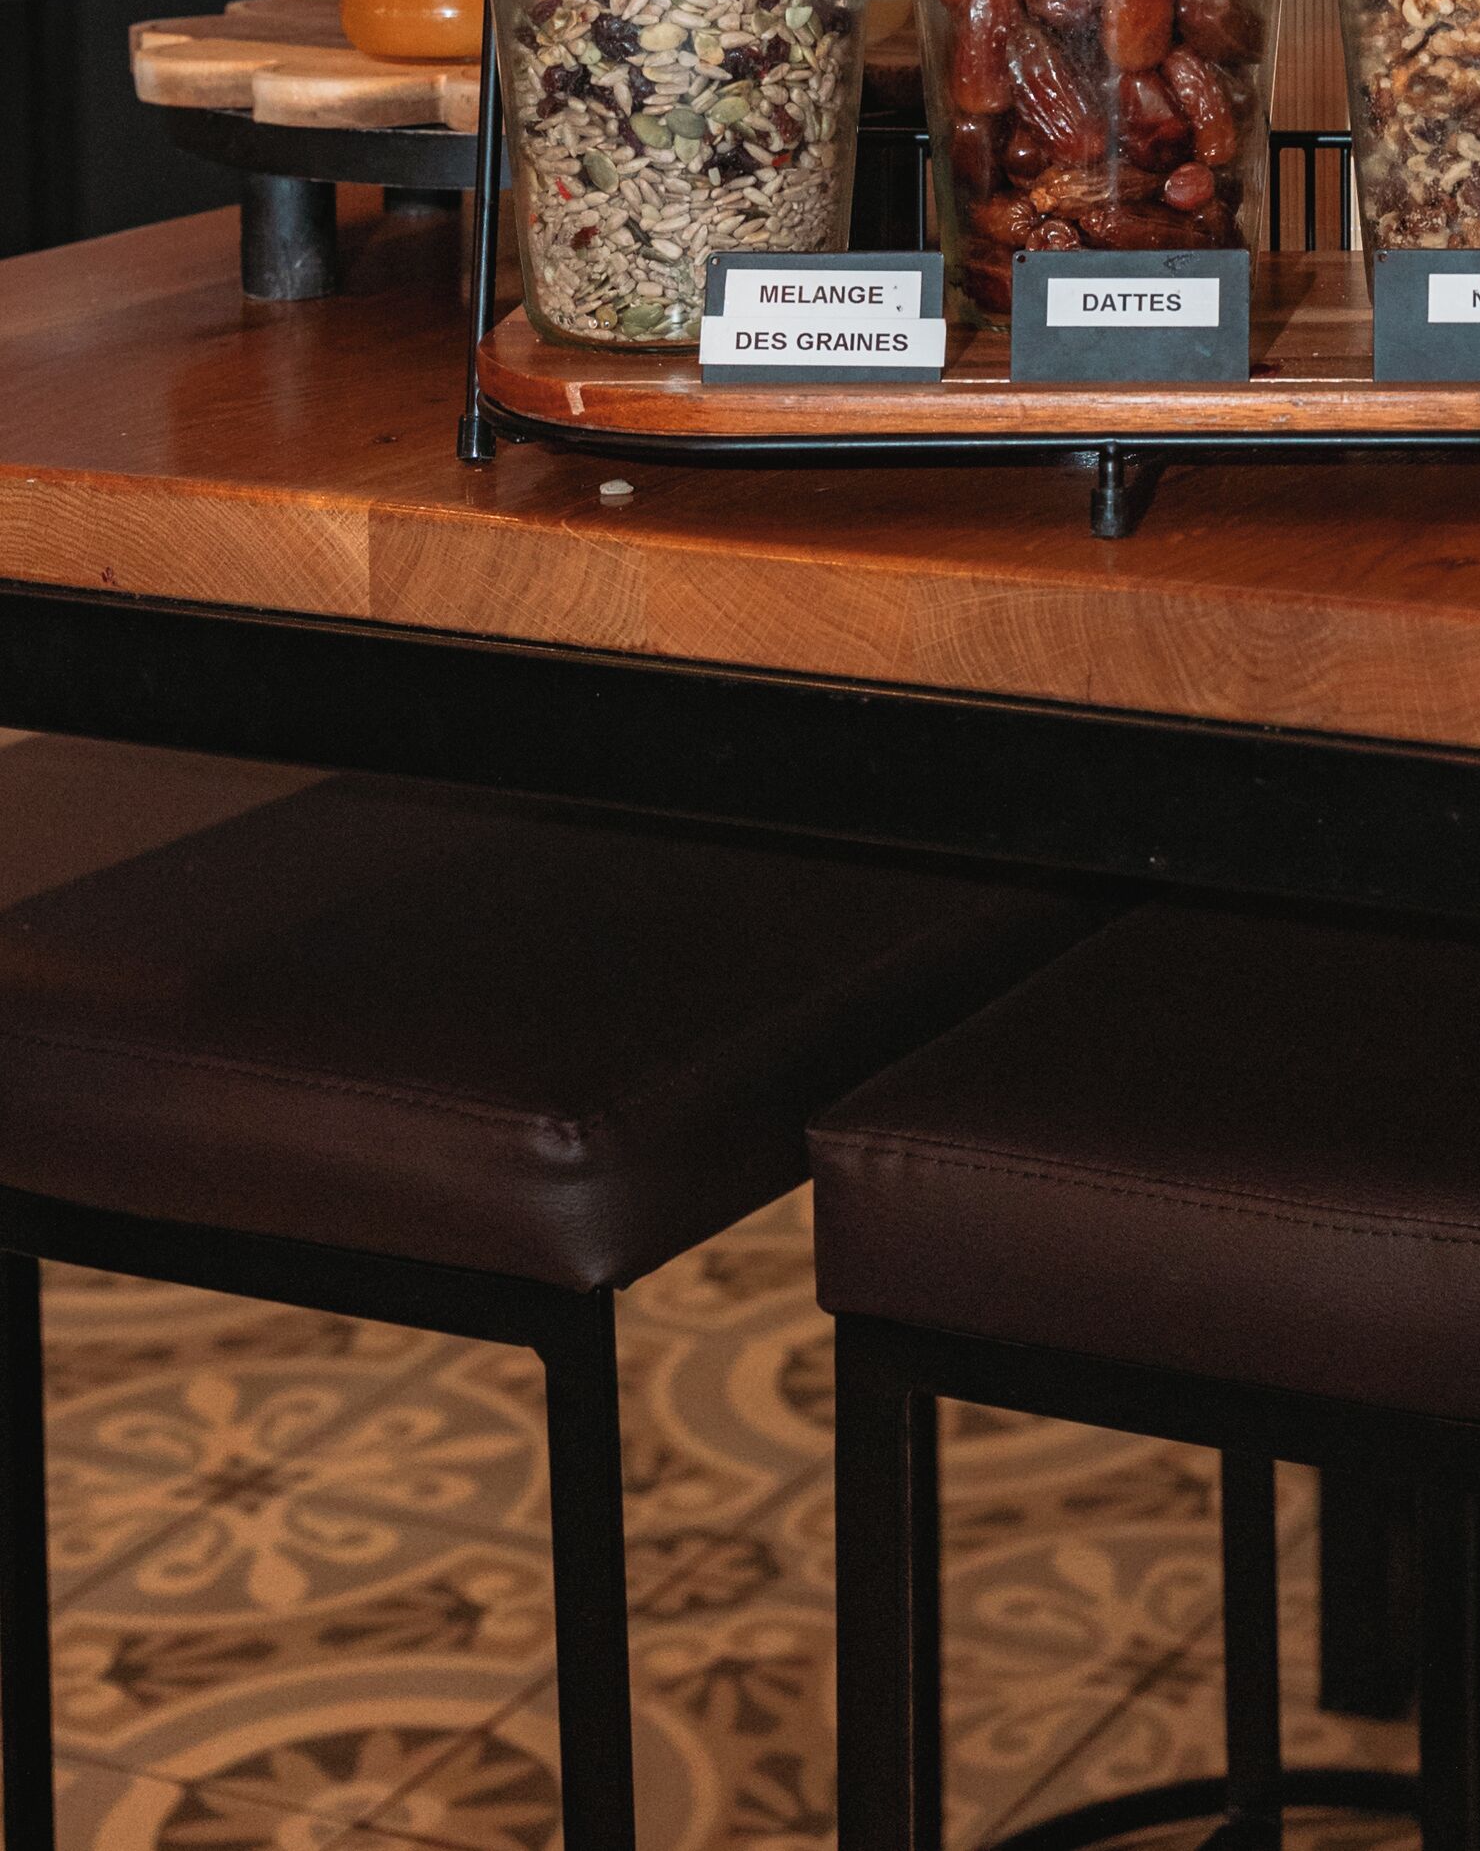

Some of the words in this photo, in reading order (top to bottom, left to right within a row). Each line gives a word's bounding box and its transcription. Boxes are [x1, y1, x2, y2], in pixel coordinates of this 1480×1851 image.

[759, 284, 884, 305] MELANGE
[1082, 293, 1182, 312] DATTES
[735, 331, 788, 351] DES
[796, 332, 909, 352] GRAINES
